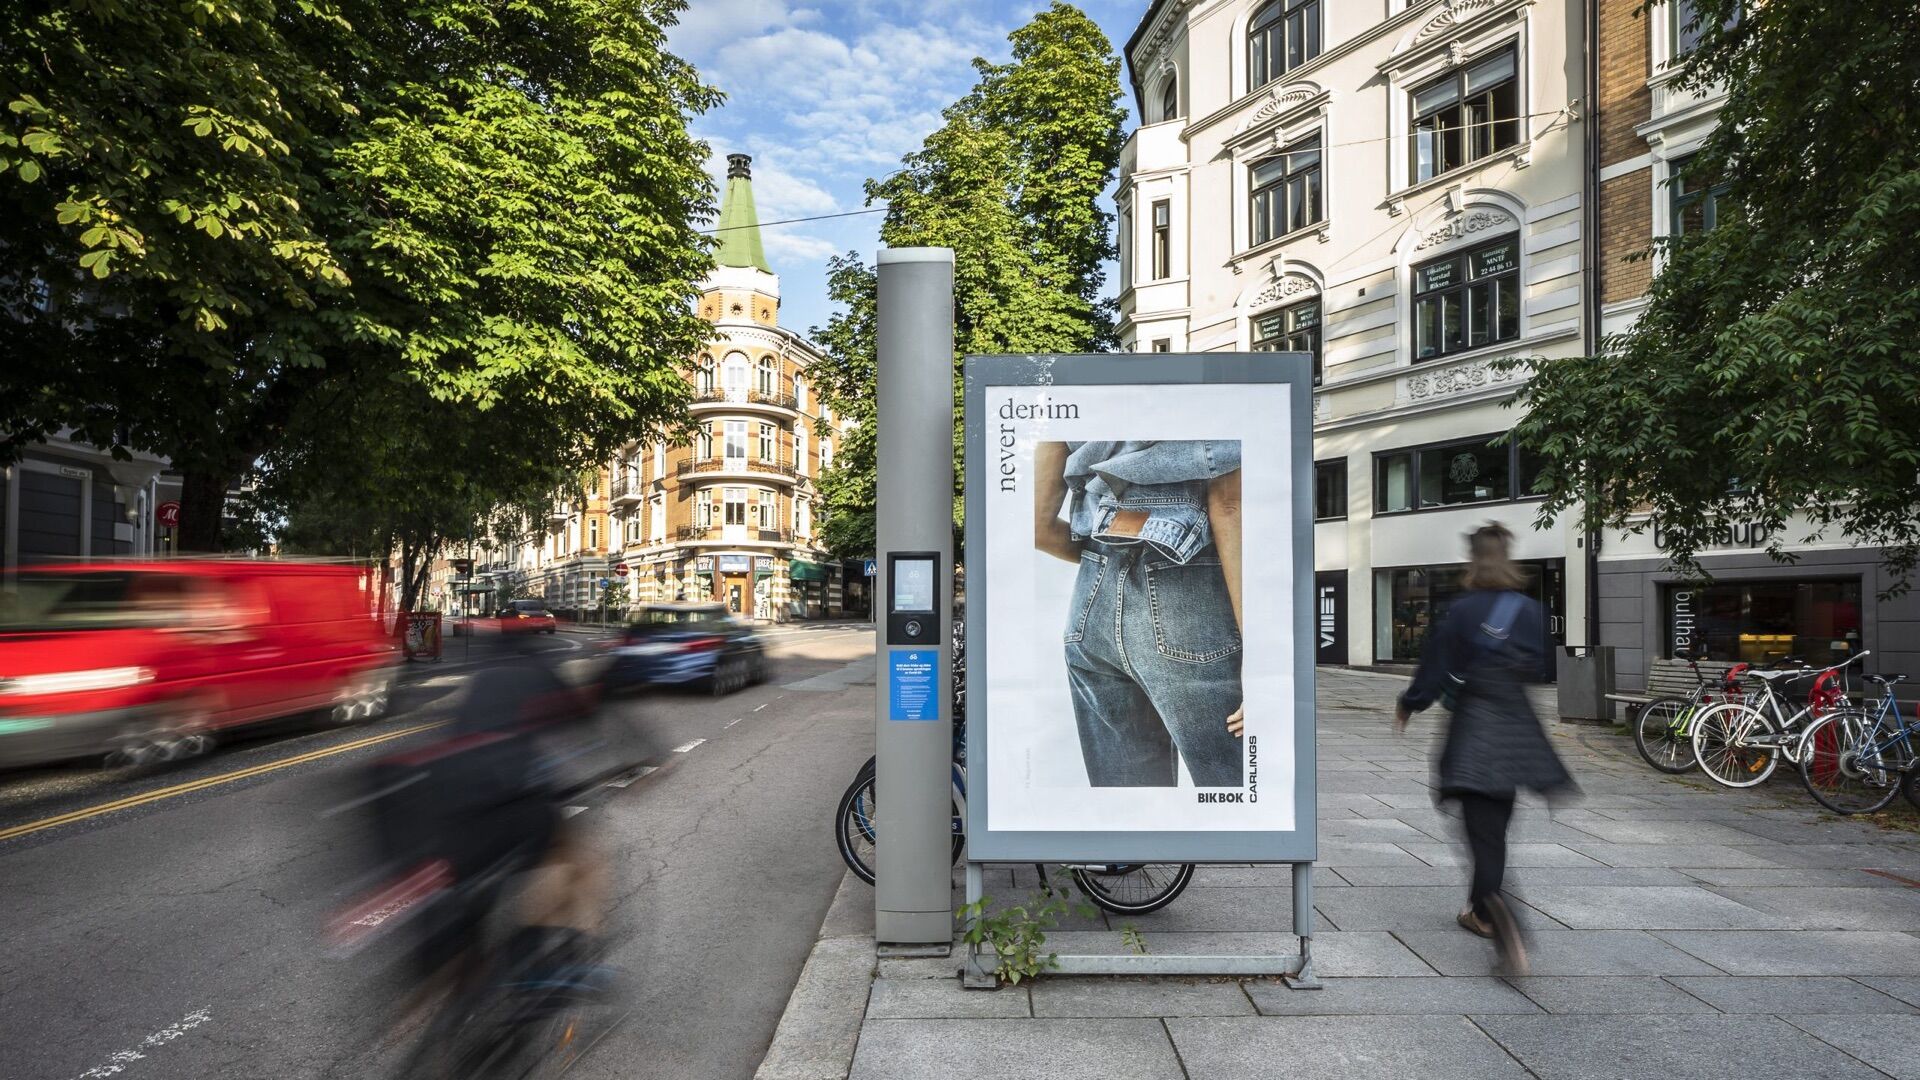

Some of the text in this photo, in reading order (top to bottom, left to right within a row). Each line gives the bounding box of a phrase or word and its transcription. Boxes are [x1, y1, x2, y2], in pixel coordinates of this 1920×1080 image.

[999, 397, 1080, 419] denim
[1000, 423, 1015, 492] never
[1249, 735, 1257, 803] CARLINGS
[1198, 793, 1243, 803] BIK BOK
